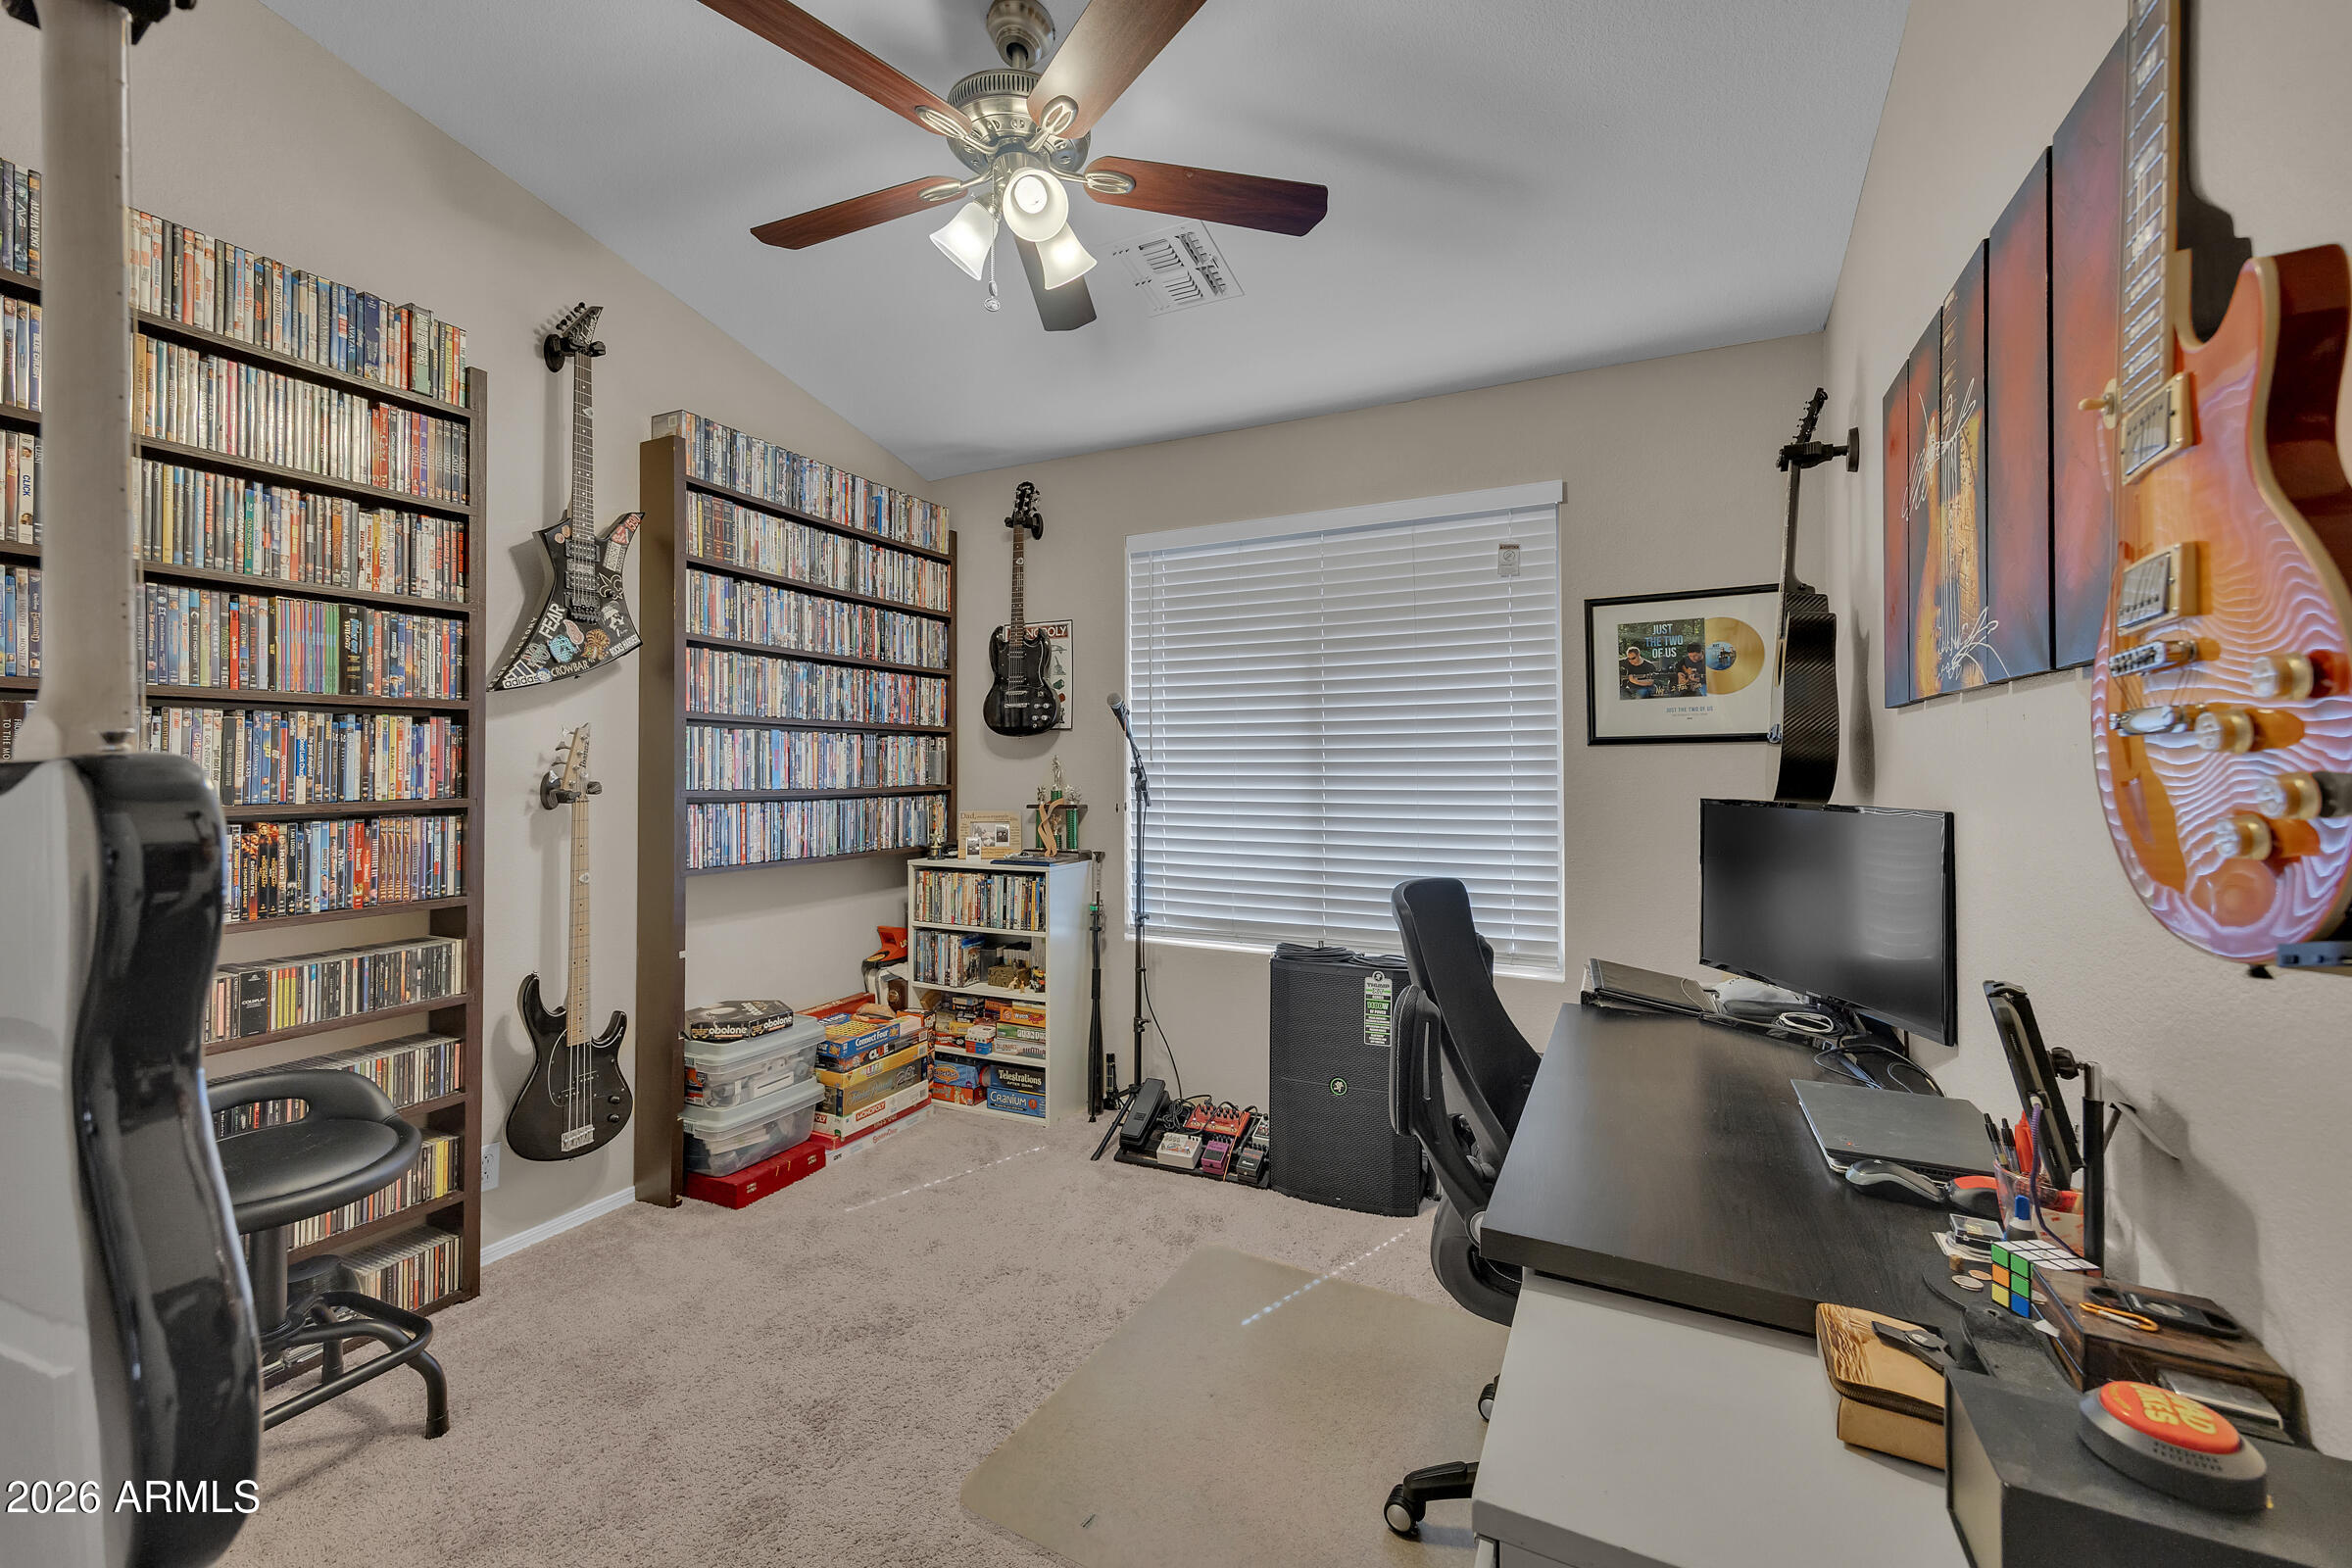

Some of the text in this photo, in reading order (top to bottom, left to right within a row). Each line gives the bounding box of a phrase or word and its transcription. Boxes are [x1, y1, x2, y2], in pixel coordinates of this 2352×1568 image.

[30, 199, 40, 247] ALPHA DOG
[23, 474, 31, 496] CLICK
[538, 603, 565, 640] FEAR
[1652, 624, 1672, 635] JUST
[1646, 634, 1684, 647] THE TWO
[1652, 647, 1677, 659] OF US
[550, 660, 590, 677] CROWBAR
[3, 718, 11, 728] TO
[709, 1023, 748, 1036] abalone
[764, 1015, 793, 1029] abalone
[855, 1029, 889, 1047] Connect Four
[869, 1043, 889, 1059] CLUE
[999, 1069, 1042, 1085] Telestrations
[990, 1091, 1026, 1106] CRANIUM
[856, 1102, 886, 1120] MONOPOLY
